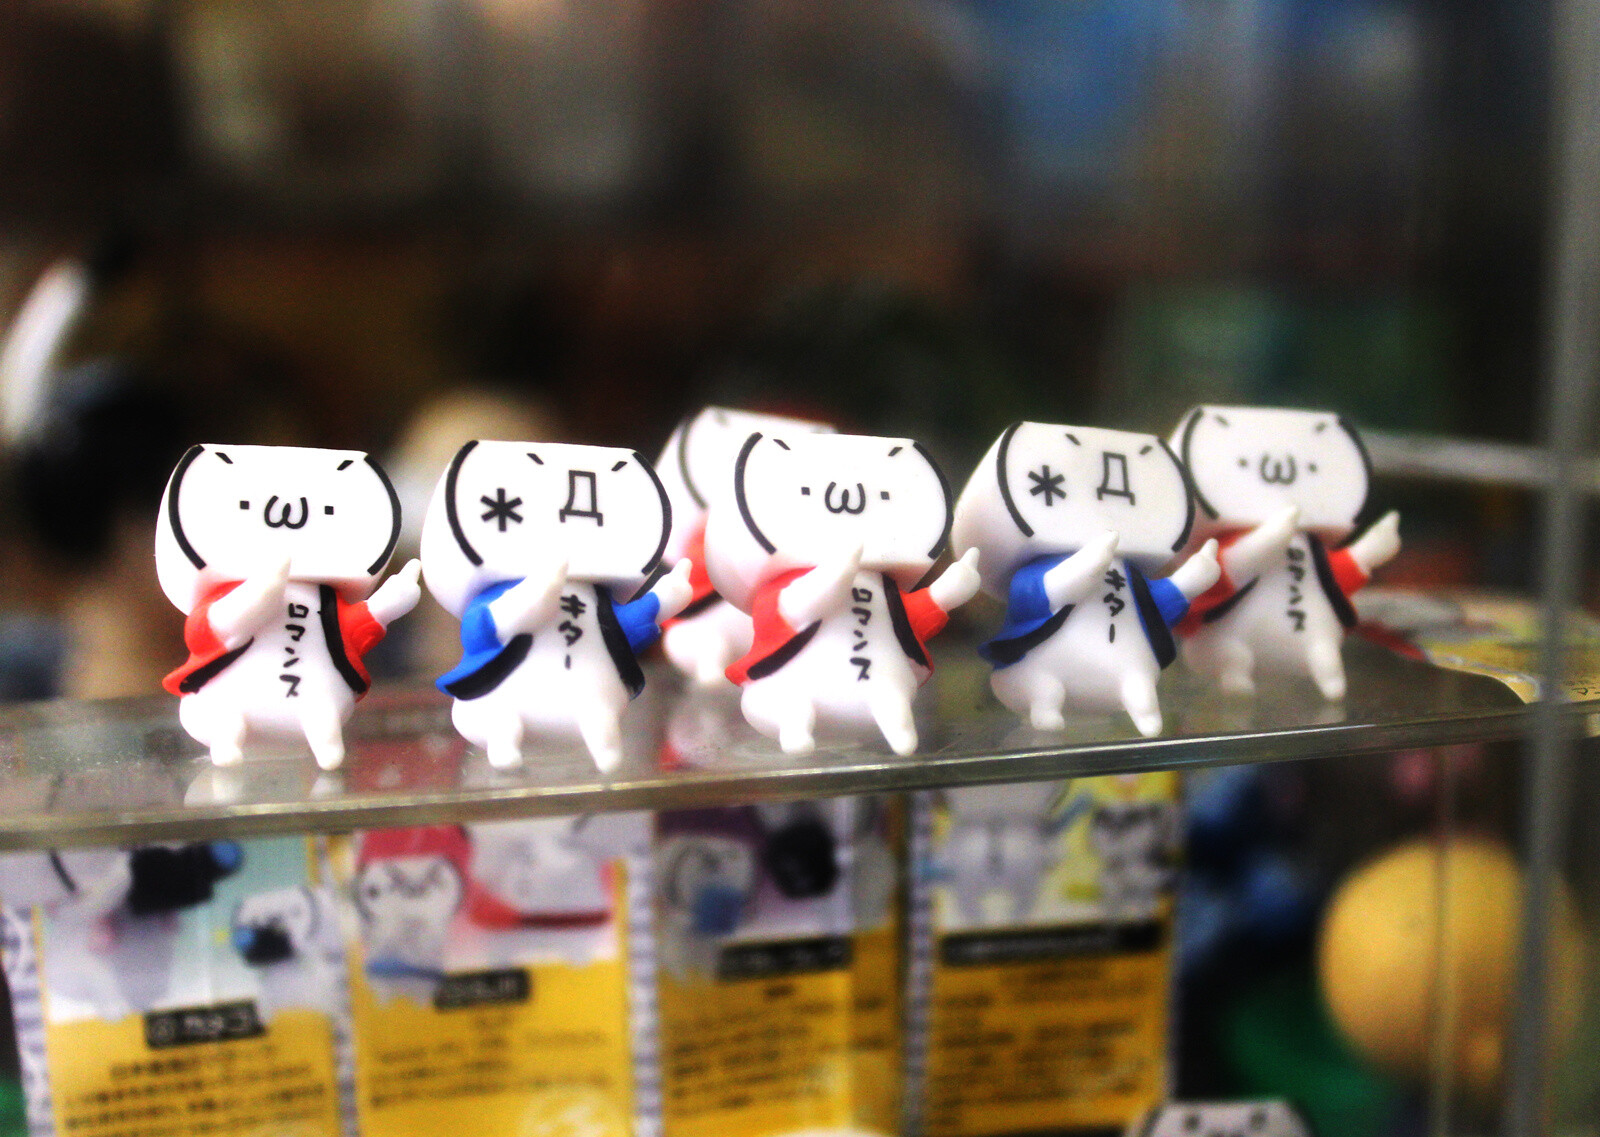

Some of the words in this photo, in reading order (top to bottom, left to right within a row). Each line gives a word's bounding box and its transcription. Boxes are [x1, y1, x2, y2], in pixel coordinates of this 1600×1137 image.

[559, 594, 587, 670] キター
[849, 587, 873, 682] ロマンス
[1102, 568, 1128, 644] キター
[278, 602, 310, 698] ロマンス
